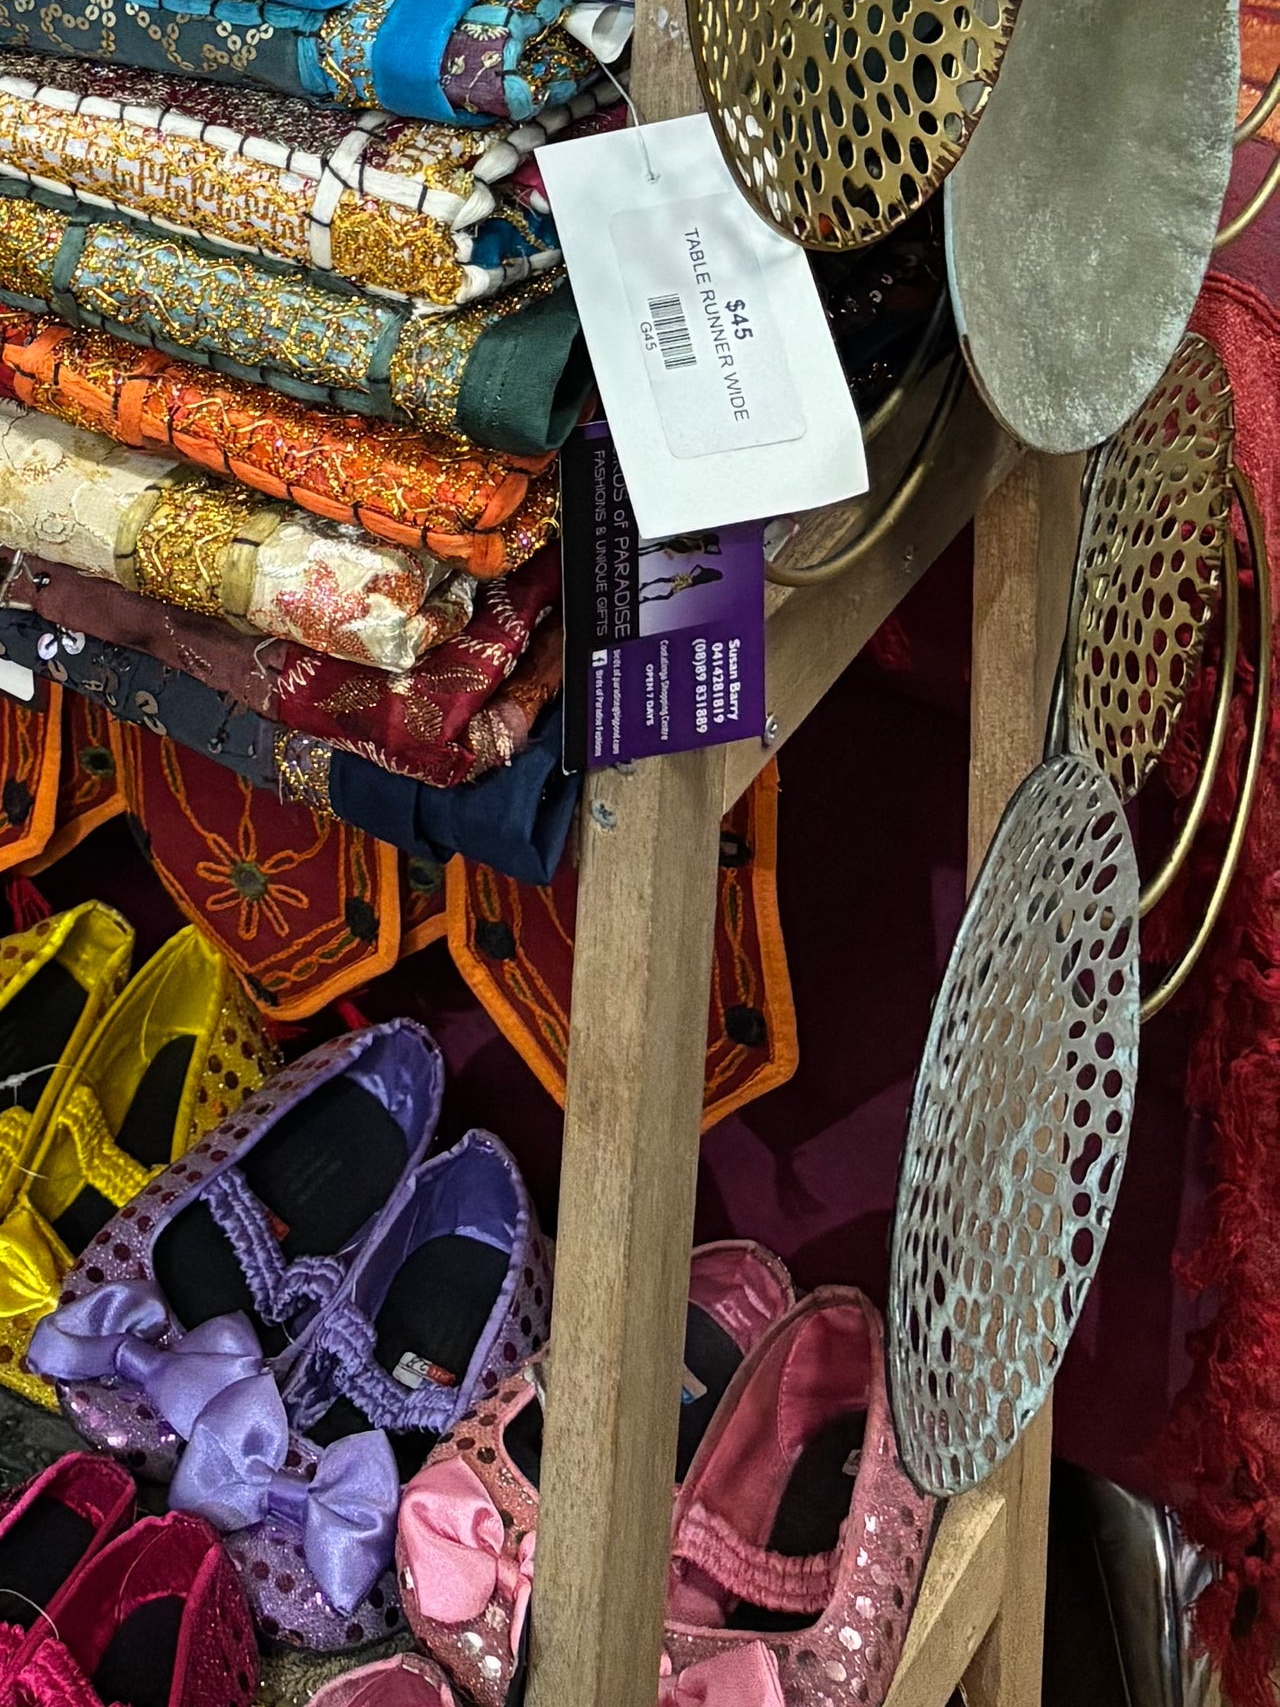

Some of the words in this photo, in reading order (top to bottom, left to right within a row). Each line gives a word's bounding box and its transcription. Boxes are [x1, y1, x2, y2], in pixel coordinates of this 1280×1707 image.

[640, 321, 658, 351] G45
[684, 227, 712, 285] TABLE
[699, 289, 734, 369] RUNNER
[724, 372, 750, 422] WIDE
[725, 298, 753, 341] $45
[593, 449, 608, 522] FASHIONS
[595, 526, 608, 536] &
[595, 539, 608, 593] UNIQUE
[613, 536, 631, 640] PARADISE
[596, 596, 608, 636] GIFTS
[691, 638, 707, 682] (08)89
[728, 638, 741, 680] Susan
[711, 642, 725, 724] 0414281819
[727, 681, 741, 721] Barry
[695, 684, 708, 734] 831889
